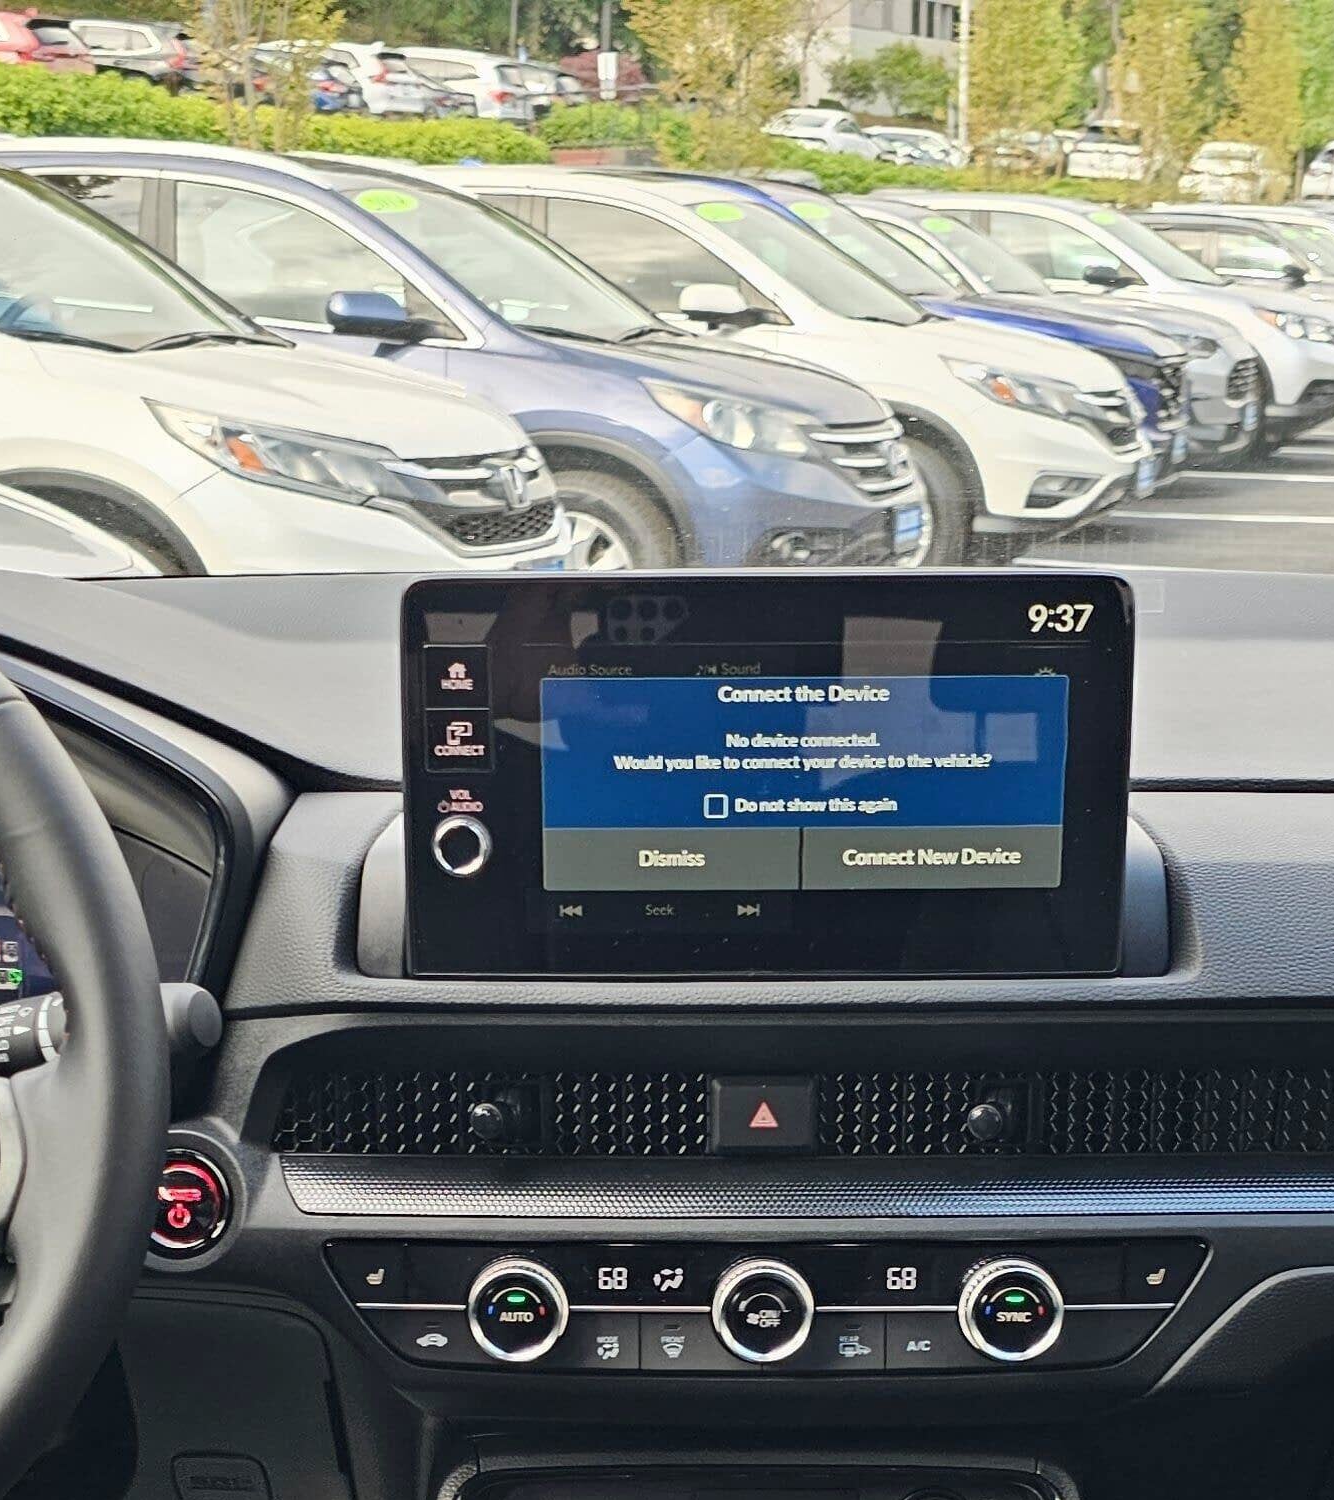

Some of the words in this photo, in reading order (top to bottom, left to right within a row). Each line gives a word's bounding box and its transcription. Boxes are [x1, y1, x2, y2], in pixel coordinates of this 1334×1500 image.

[1026, 603, 1094, 633] 9:37
[547, 664, 586, 676] Audio
[590, 664, 633, 676] Source
[721, 662, 761, 675] Sound
[440, 679, 474, 690] HOME
[717, 685, 793, 702] Connect
[795, 685, 825, 702] the
[828, 685, 890, 701] Device
[725, 734, 749, 748] No
[751, 733, 799, 748] device
[800, 732, 880, 747] connected.
[434, 745, 485, 756] CONNECT
[613, 755, 663, 769] Would
[666, 757, 693, 772] you
[695, 755, 721, 770] like
[723, 756, 740, 769] to
[742, 755, 803, 769] connect
[803, 757, 838, 771] your
[839, 755, 886, 769] device
[887, 756, 903, 769] to
[906, 754, 932, 768] the
[933, 753, 992, 768] vehicle?
[449, 789, 472, 800] VOL
[735, 799, 755, 812] Do
[758, 799, 784, 812] not
[786, 798, 827, 812] show
[829, 798, 856, 812] this
[858, 798, 898, 814] again
[638, 850, 706, 867] Dismiss
[842, 849, 915, 866] Connect
[917, 849, 958, 865] New
[961, 847, 1022, 865] Device
[645, 903, 674, 916] Seek
[598, 1267, 628, 1290] 68
[886, 1267, 917, 1290] 68
[499, 1311, 535, 1323] AUTO
[759, 1318, 781, 1327] OFF
[996, 1311, 1032, 1323] SYNC
[906, 1340, 931, 1351] A/C
